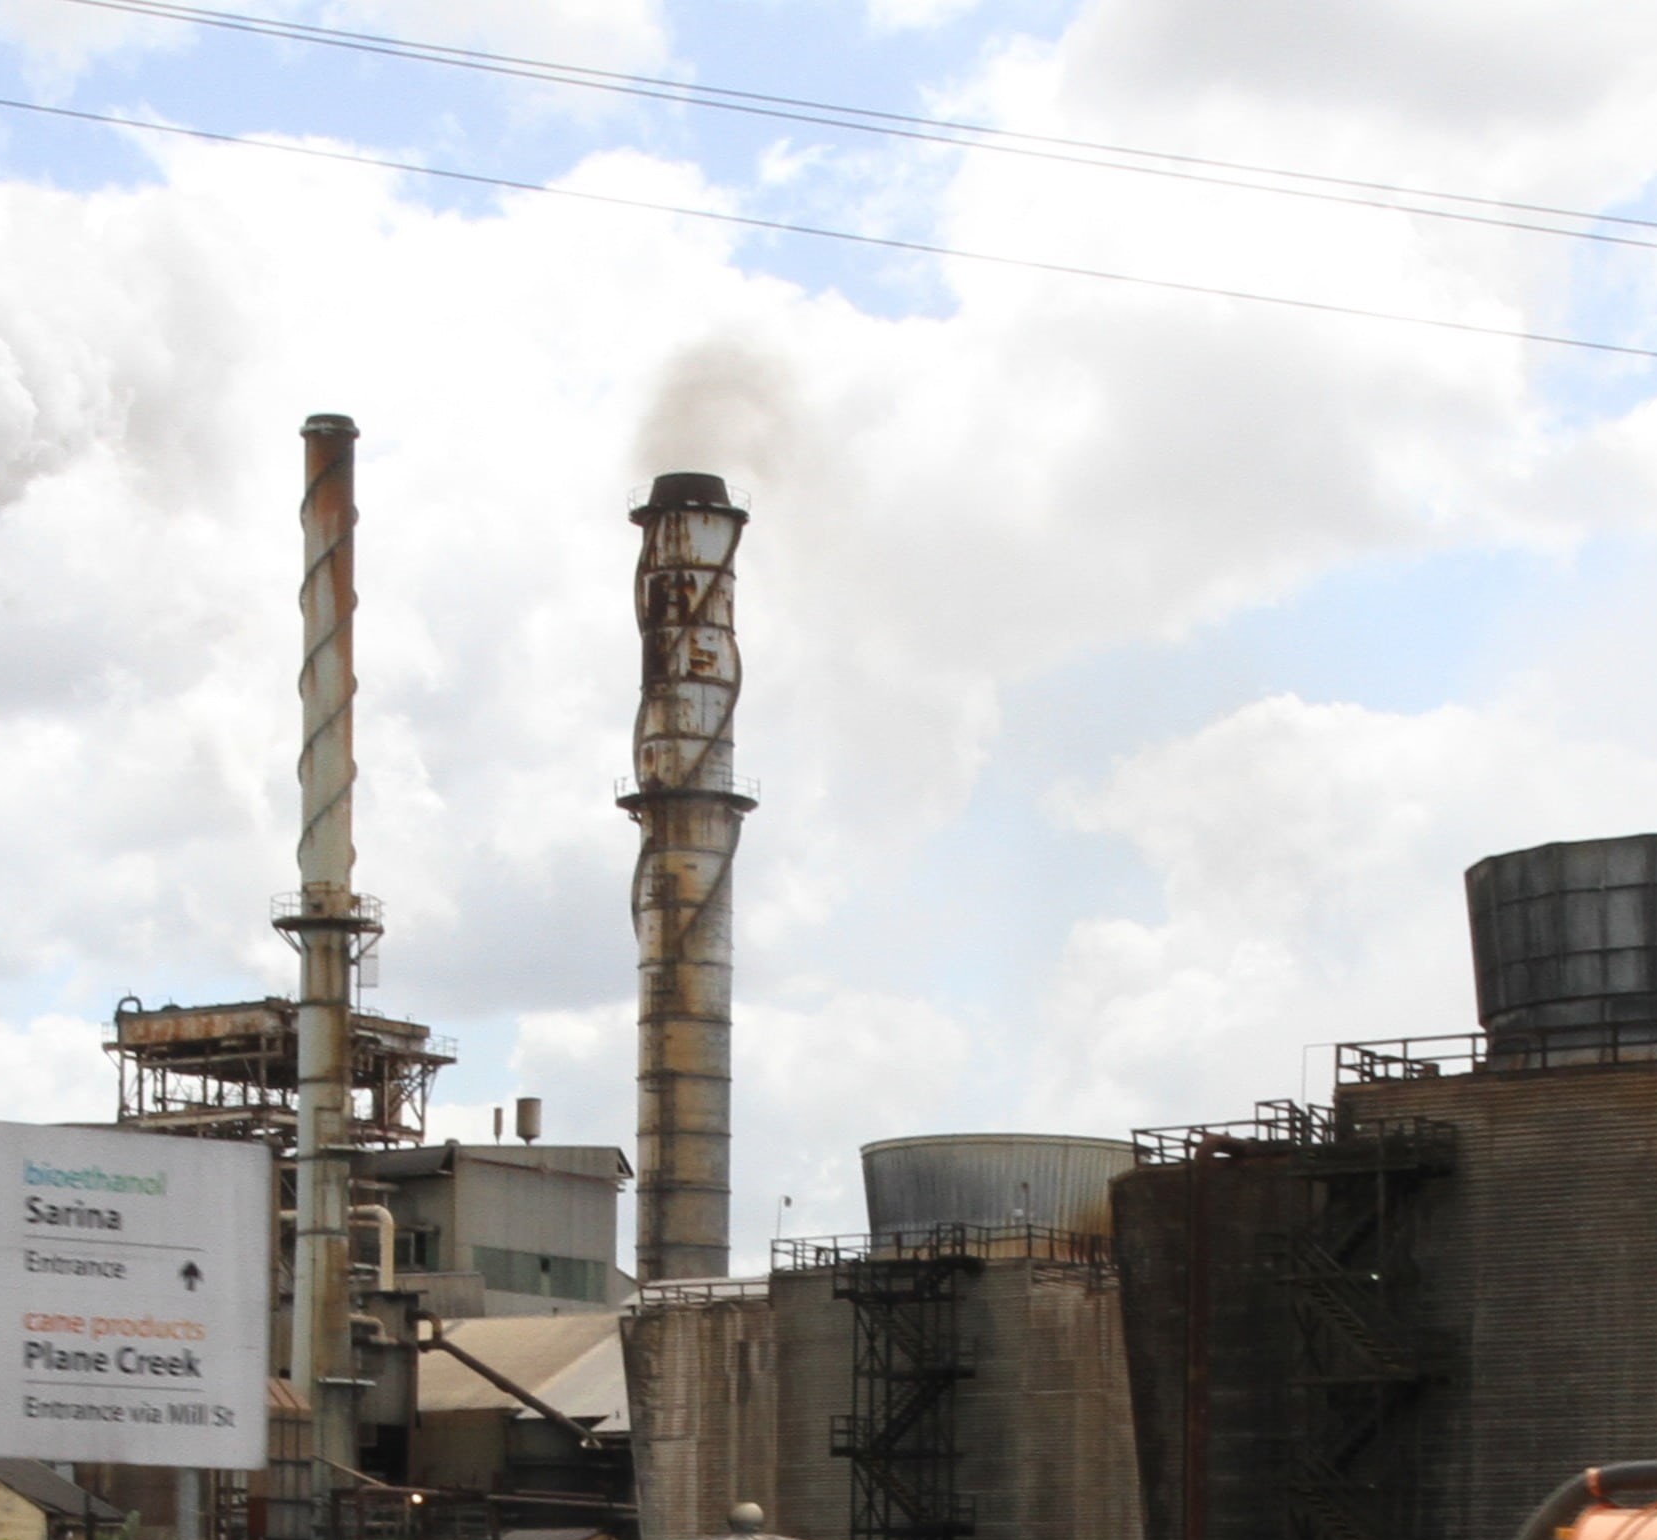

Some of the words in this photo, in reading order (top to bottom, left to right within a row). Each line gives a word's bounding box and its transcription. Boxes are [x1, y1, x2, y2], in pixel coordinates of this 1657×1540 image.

[23, 1159, 168, 1195] bioethanol
[25, 1195, 122, 1230] Sarina
[24, 1251, 127, 1280] Entrance
[23, 1312, 86, 1334] cane
[90, 1315, 206, 1343] products
[24, 1340, 109, 1373] Plane
[117, 1346, 202, 1378] Creek
[24, 1395, 126, 1423] Entrance
[127, 1402, 162, 1425] via
[168, 1401, 209, 1426] Mill
[212, 1404, 236, 1428] St
